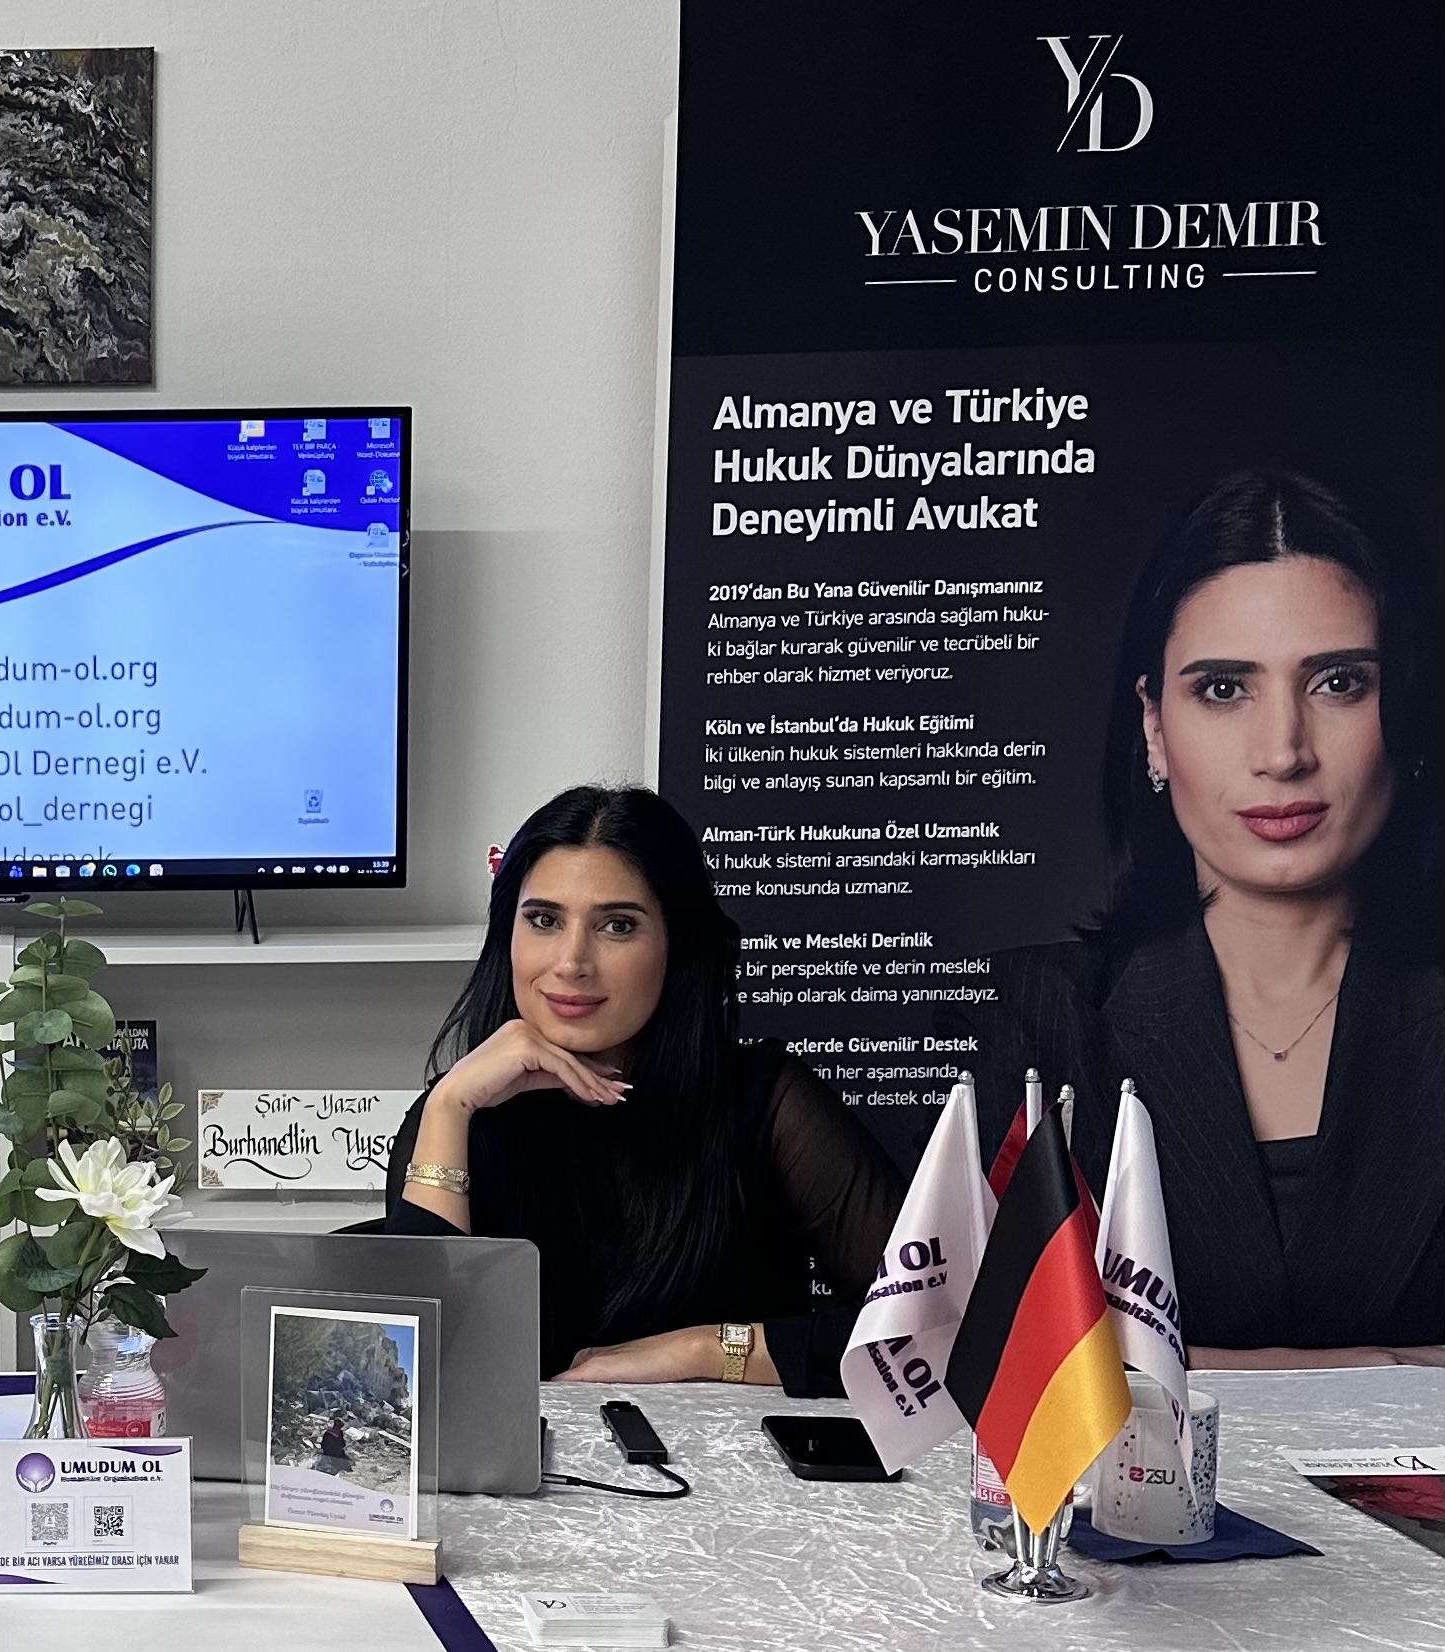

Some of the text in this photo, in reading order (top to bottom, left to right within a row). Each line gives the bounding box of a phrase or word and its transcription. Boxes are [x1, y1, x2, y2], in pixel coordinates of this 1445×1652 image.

[854, 200, 1326, 257] YASEMIN DEMIR
[974, 263, 1205, 294] CONSULTING
[712, 386, 1089, 435] Almanya ve Türkiye
[713, 439, 1095, 486] Hukuk Dünyalarında
[9, 463, 71, 500] OL
[36, 509, 71, 527] e.V.
[712, 495, 1039, 542] Deneyimli Avukat
[787, 583, 810, 599] Bu
[813, 581, 854, 599] Yana
[857, 579, 931, 598] Güvenilir
[934, 579, 1044, 599] Danışmanınız
[707, 605, 1050, 632] Almanya ve Türkiye arasında sağlam huku-
[707, 633, 1040, 660] ki bağlar kurarak güvenilir ve tecrübeli bir
[706, 664, 954, 685] rehber olarak hizmet veriyoruz.
[705, 719, 742, 736] Köln
[745, 722, 766, 735] ve
[862, 715, 915, 732] Hukuk
[919, 713, 975, 735] Eğitimi
[705, 740, 1046, 763] İki ülkenin hukuk sistemleri hakkında derin
[33, 749, 146, 781] Dernegi
[157, 748, 208, 774] e.V.
[703, 768, 1037, 794] bilgi ve anlayış sunan kapsamlı bir eğitim.
[701, 819, 1000, 843] Alman-Türk Hukukuna Özel Uzmanlık
[725, 849, 1035, 869] hukuk sistemi arasındaki karmaşıklıkları
[756, 880, 913, 895] konusunda uzmanız.
[740, 932, 933, 950] emik ve Mesleki Derinlik
[746, 958, 990, 979] bir perspektife ve derin mesleki
[752, 986, 998, 1005] sahip olarak daima yanınızdayız.
[849, 1038, 919, 1052] Güvenilir
[923, 1036, 978, 1052] Destek
[837, 1065, 863, 1080] her
[256, 1093, 300, 1119] Şair
[843, 1090, 918, 1105] bir destek
[899, 1237, 947, 1271] OL
[903, 1358, 941, 1409] OL
[61, 1460, 163, 1473] UMUDUM OL
[1145, 1470, 1175, 1485] ZSU
